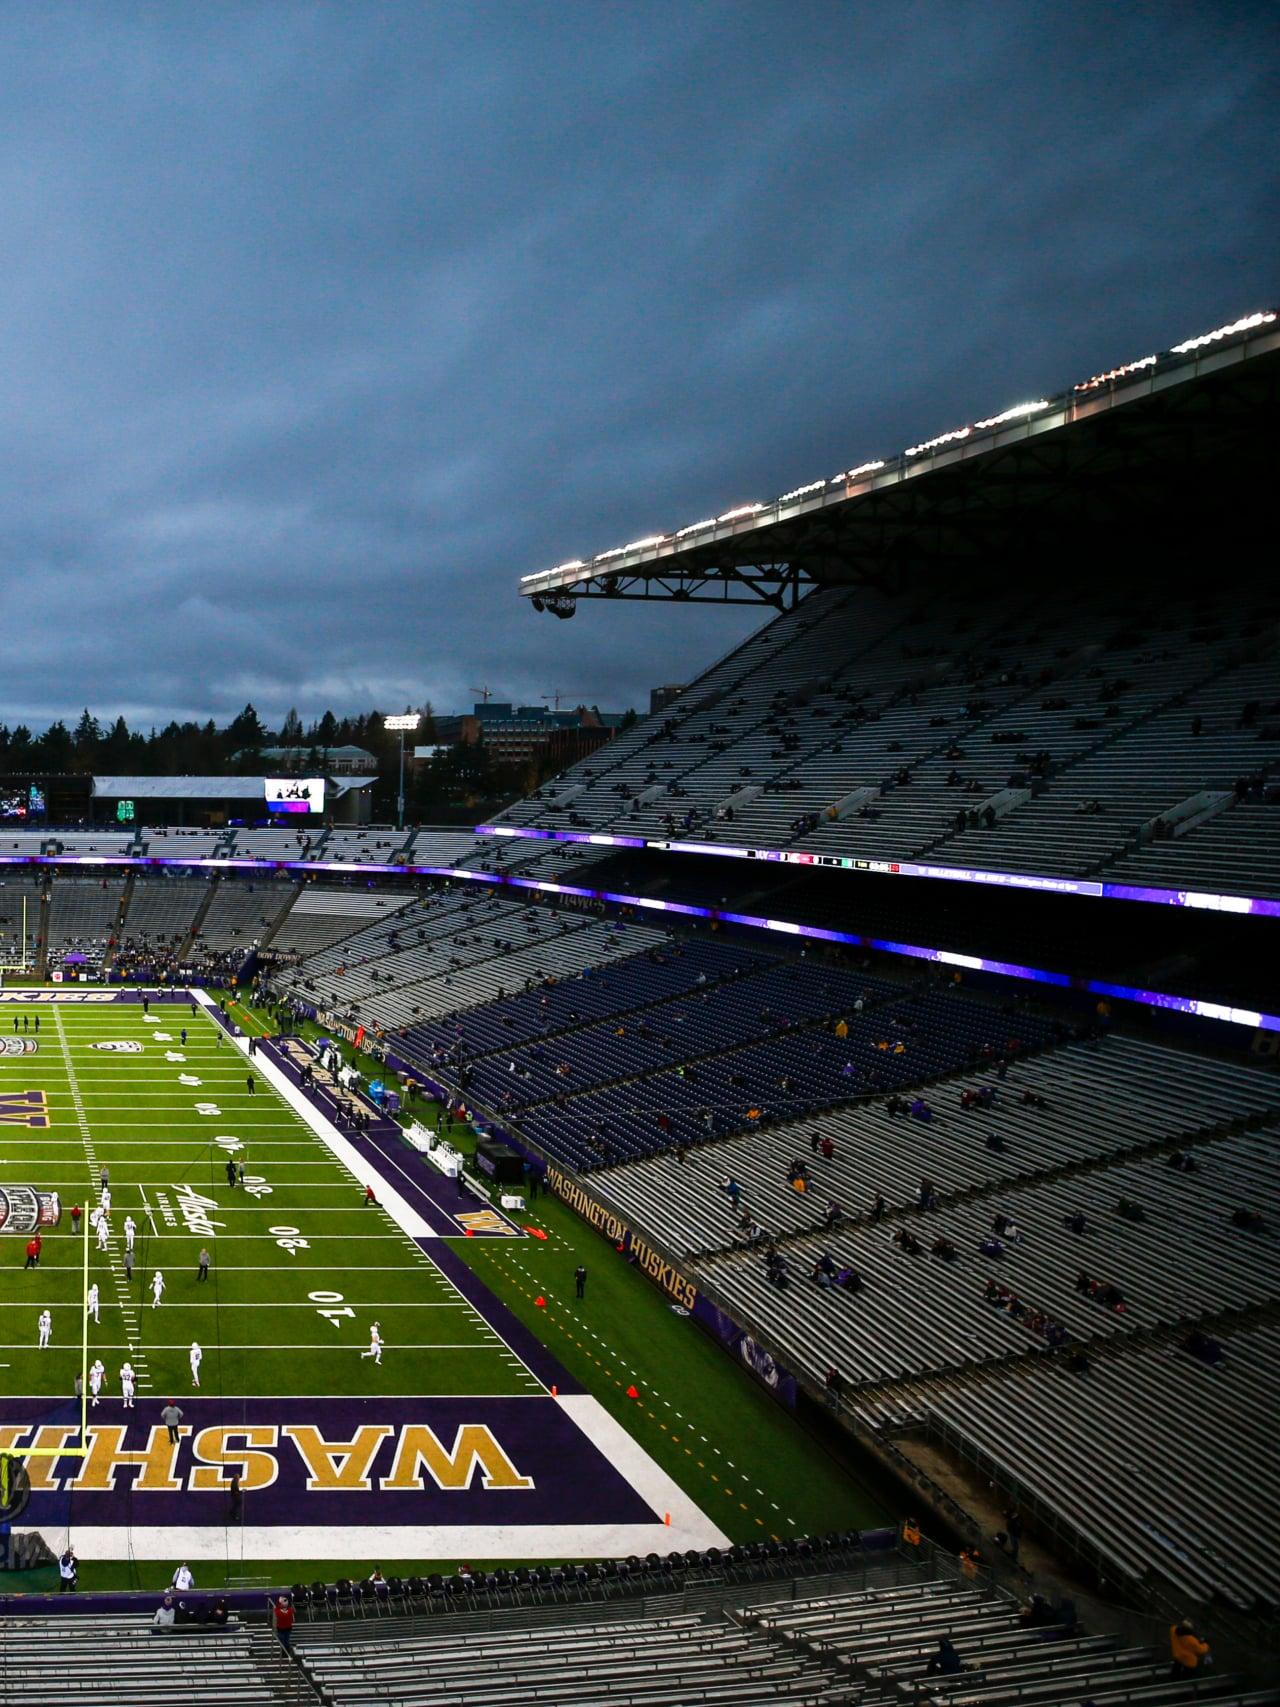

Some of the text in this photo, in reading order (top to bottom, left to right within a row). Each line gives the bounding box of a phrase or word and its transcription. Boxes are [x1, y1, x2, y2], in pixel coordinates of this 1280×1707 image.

[155, 1192, 177, 1227] AIRLINES
[171, 1184, 226, 1236] Alaska
[268, 1226, 311, 1249] 20
[547, 1165, 697, 1310] WASHINGTON HUSKIES
[308, 1291, 356, 1317] 10
